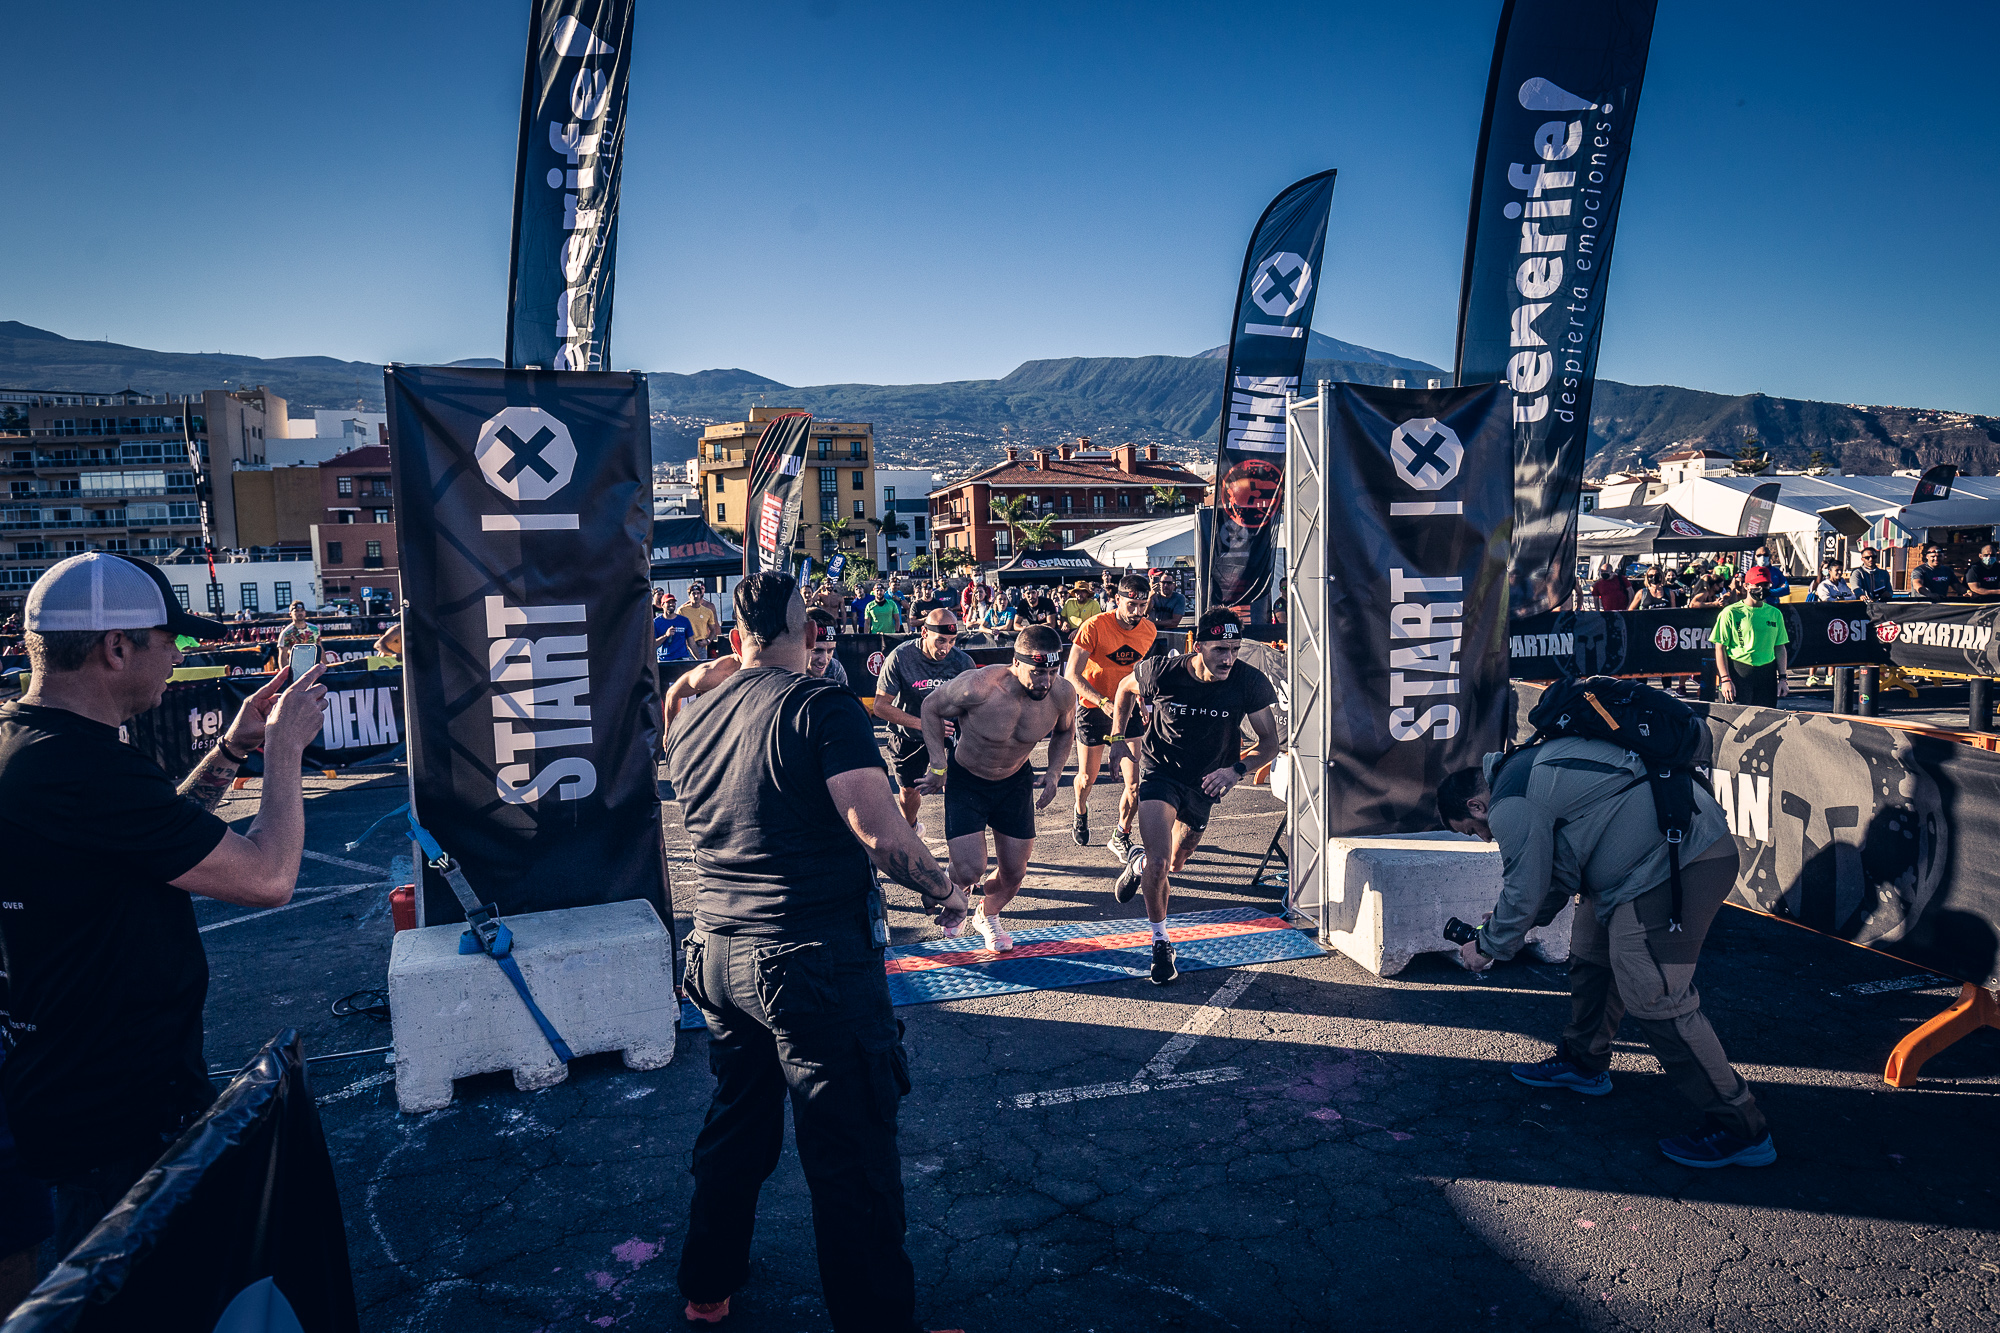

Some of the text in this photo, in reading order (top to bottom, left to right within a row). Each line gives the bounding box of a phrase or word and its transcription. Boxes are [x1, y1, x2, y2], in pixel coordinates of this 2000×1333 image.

[1503, 77, 1613, 430] tenerife!
[1554, 121, 1611, 424] despierta emociones
[1225, 375, 1299, 454] DEKA
[779, 501, 792, 546] SUPPLIER
[1037, 557, 1092, 568] SPARTAN
[363, 588, 370, 596] P
[323, 622, 351, 631] SPARTAN
[1224, 623, 1239, 634] DEKA
[1900, 622, 1991, 650] SPARTAN
[1389, 568, 1464, 741] START
[1510, 633, 1574, 658] ARTAN
[484, 595, 597, 805] START
[1168, 706, 1230, 718] METHOD
[322, 687, 399, 750] DEKA
[1695, 766, 1770, 842] AN
[2, 901, 24, 910] OVER
